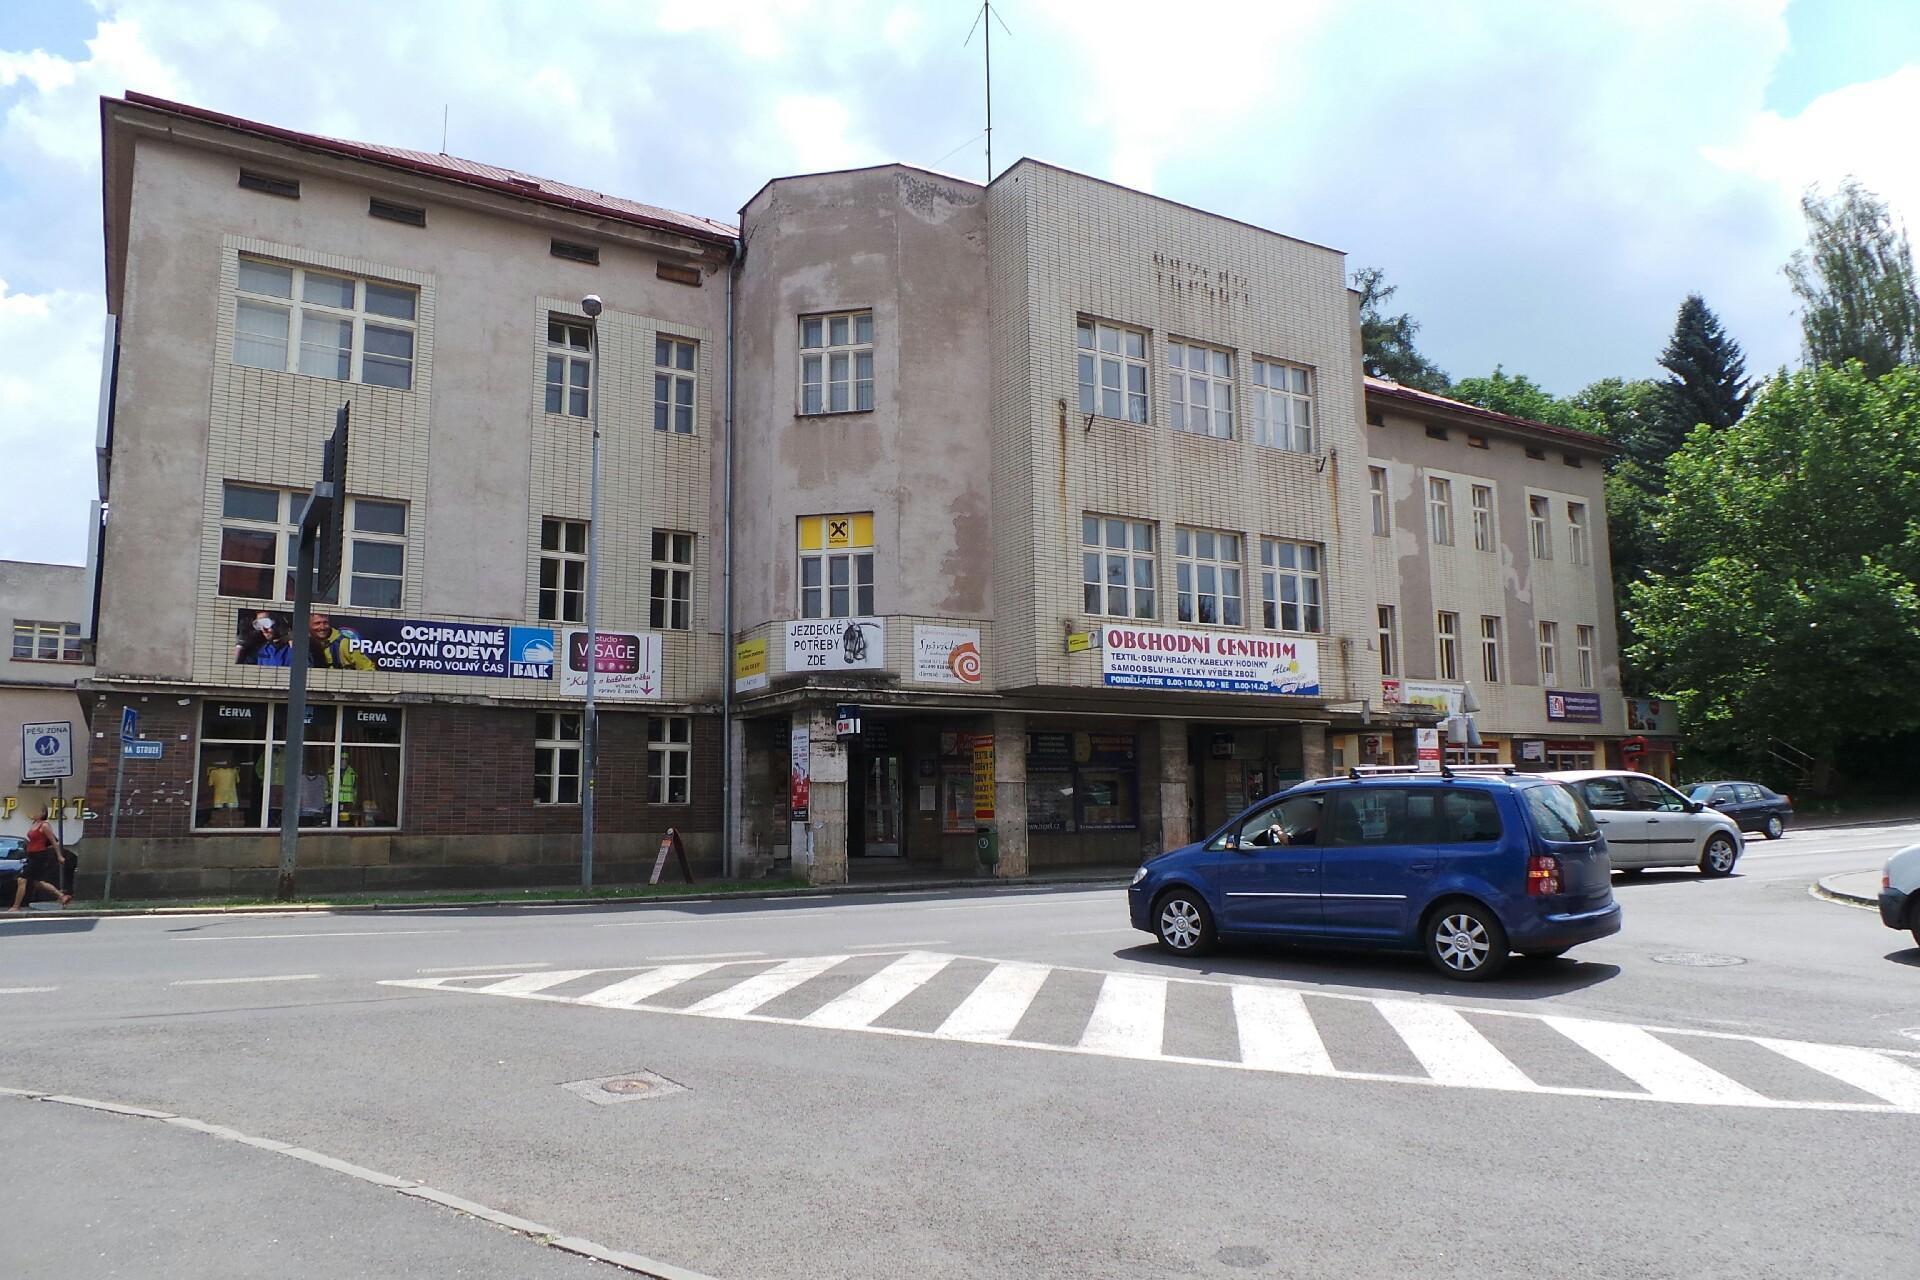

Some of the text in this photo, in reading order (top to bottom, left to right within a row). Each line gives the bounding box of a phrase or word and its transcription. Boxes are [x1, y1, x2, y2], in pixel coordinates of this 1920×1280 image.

[401, 626, 505, 645] OCHRANNÉ
[791, 620, 843, 636] JEZDECKÉ
[349, 639, 505, 660] PRACOVNÍ ODĚVY
[577, 642, 636, 659] VSAGE
[794, 636, 839, 651] POTŘEBY
[1107, 629, 1296, 659] OBCHODNÍ CENTRUM
[378, 656, 504, 673] ODĚVY PRO VOLNÝ ČAS
[807, 655, 826, 665] ZDE
[513, 663, 549, 677] BMK
[1111, 664, 1174, 674] SAMOOBSLUHA
[1181, 666, 1206, 676] VELKÝ
[1208, 667, 1233, 677] VÝBĚR
